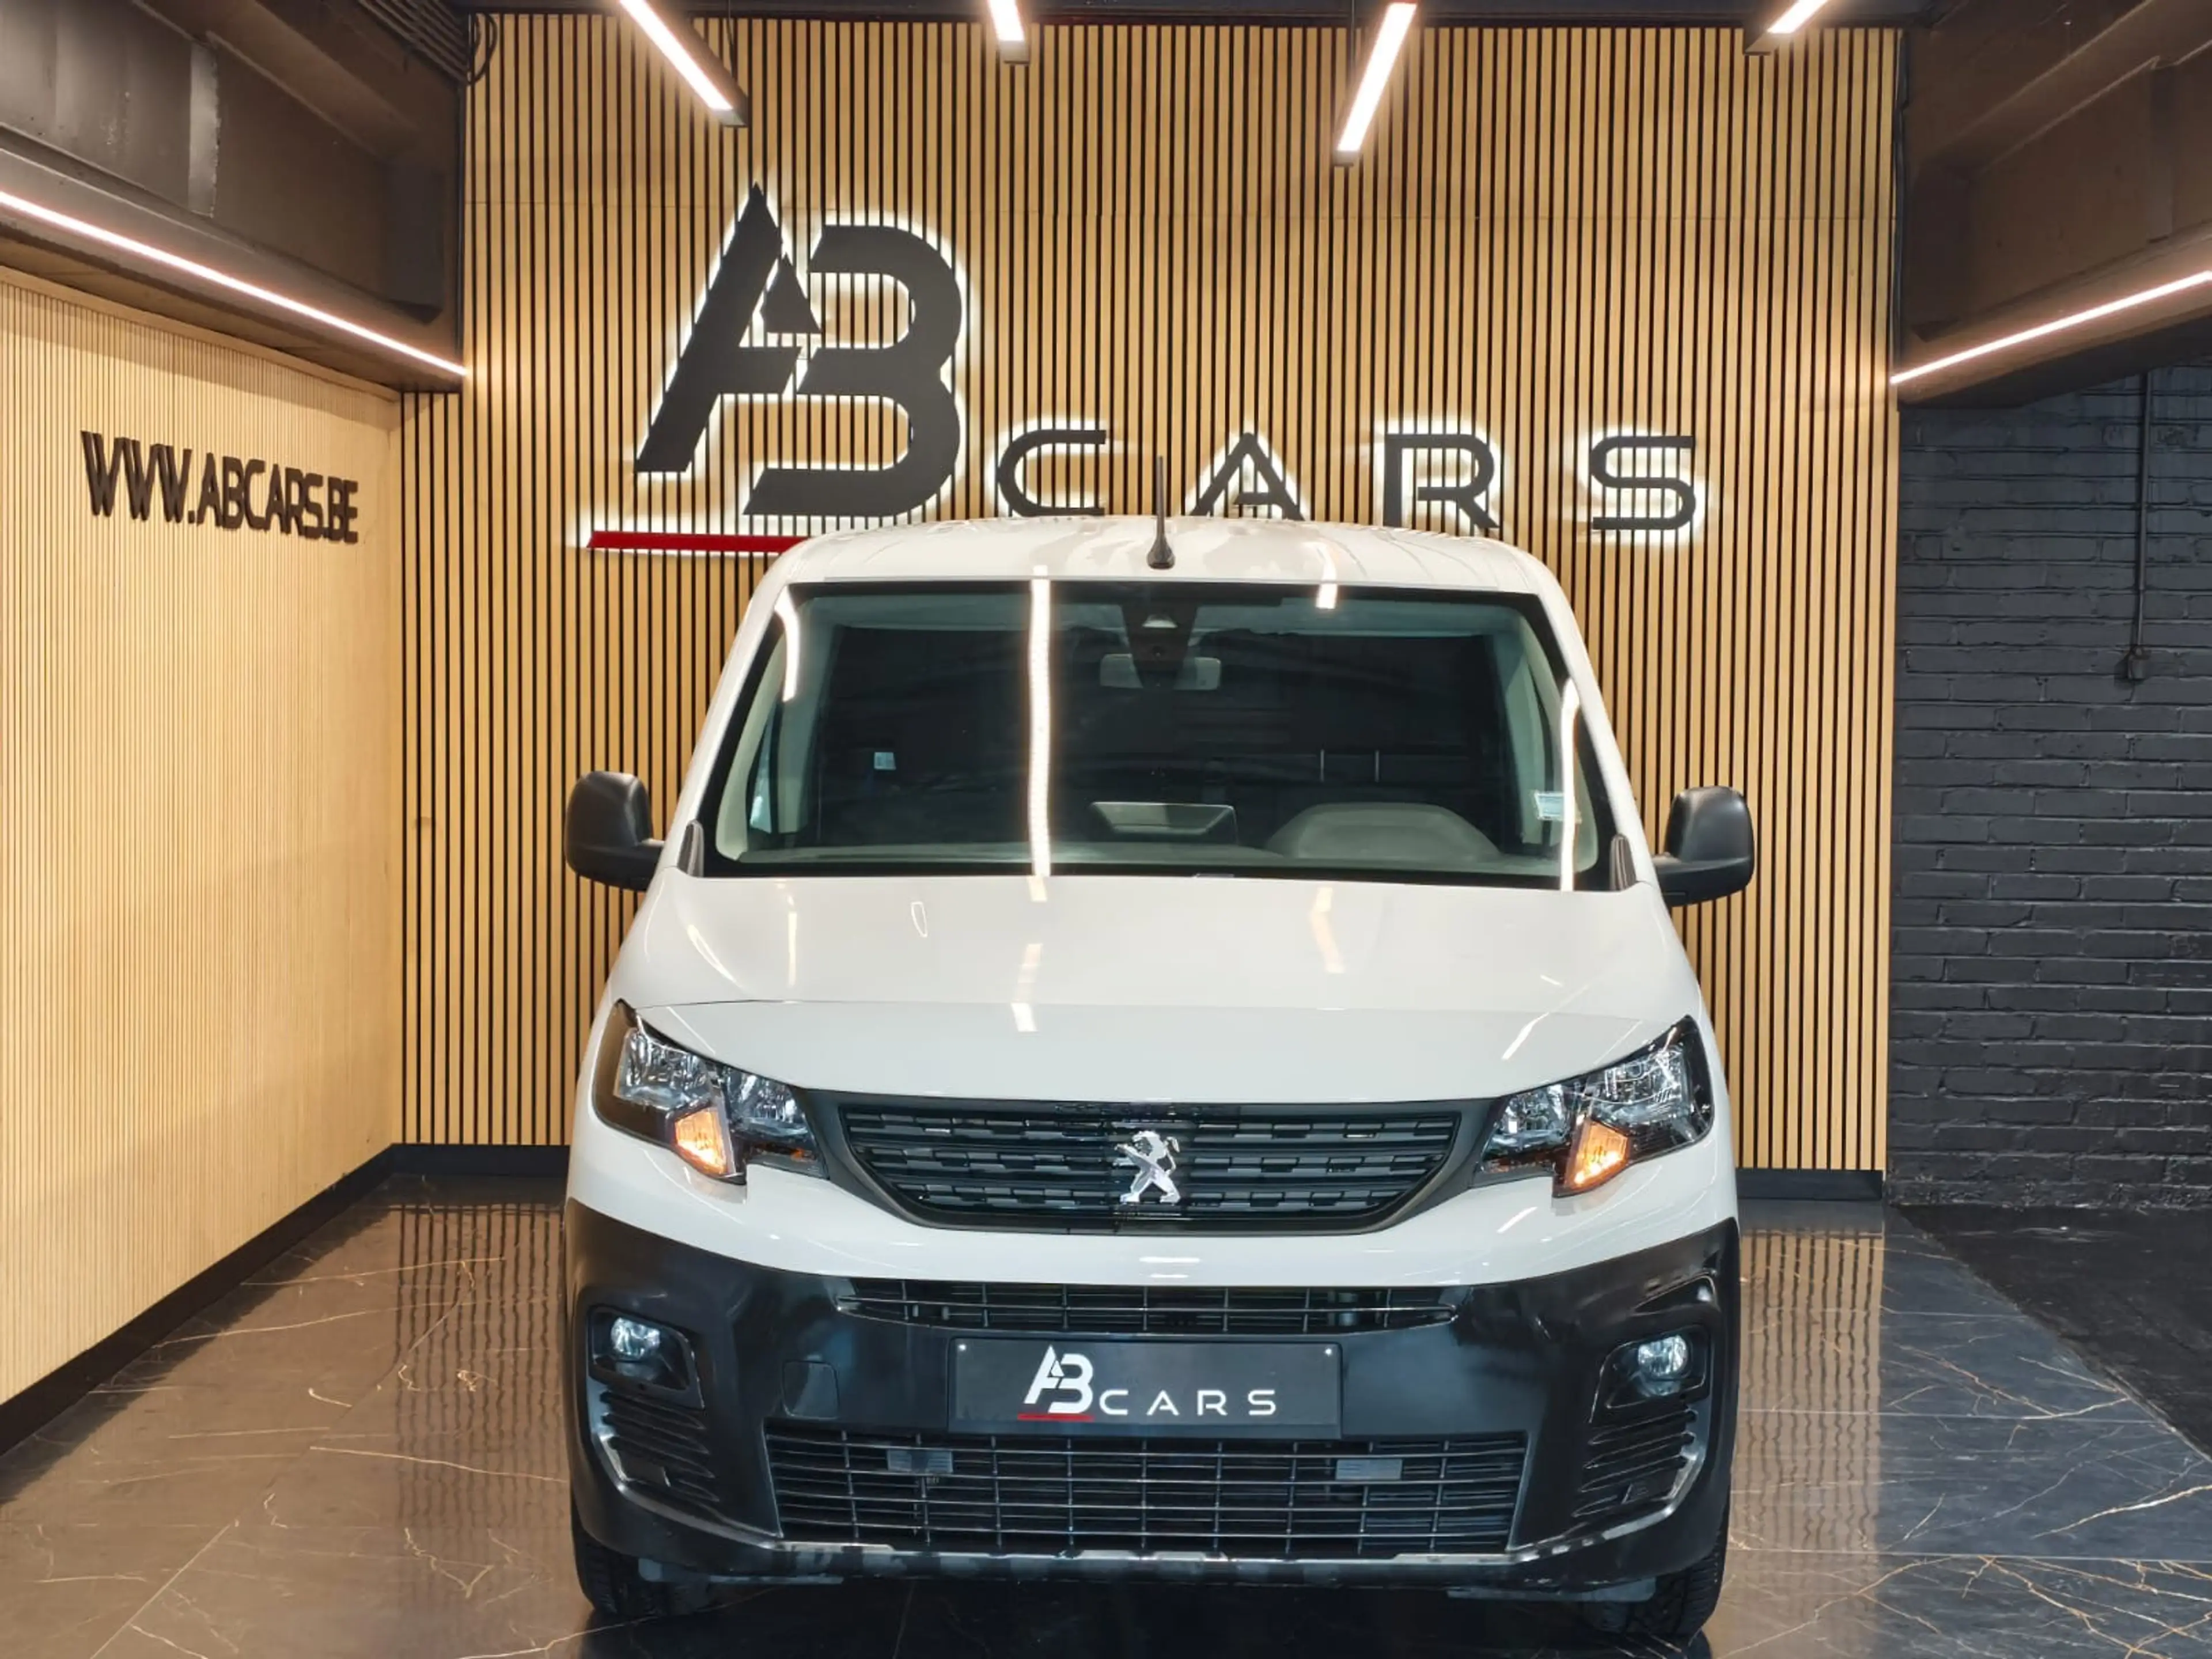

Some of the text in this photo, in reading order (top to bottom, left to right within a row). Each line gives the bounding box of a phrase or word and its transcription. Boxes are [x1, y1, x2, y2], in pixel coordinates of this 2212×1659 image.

[635, 182, 1696, 530] AB CARS
[81, 430, 358, 544] WWW.ABCARS.BE
[1024, 1345, 1277, 1416] AB CARS
